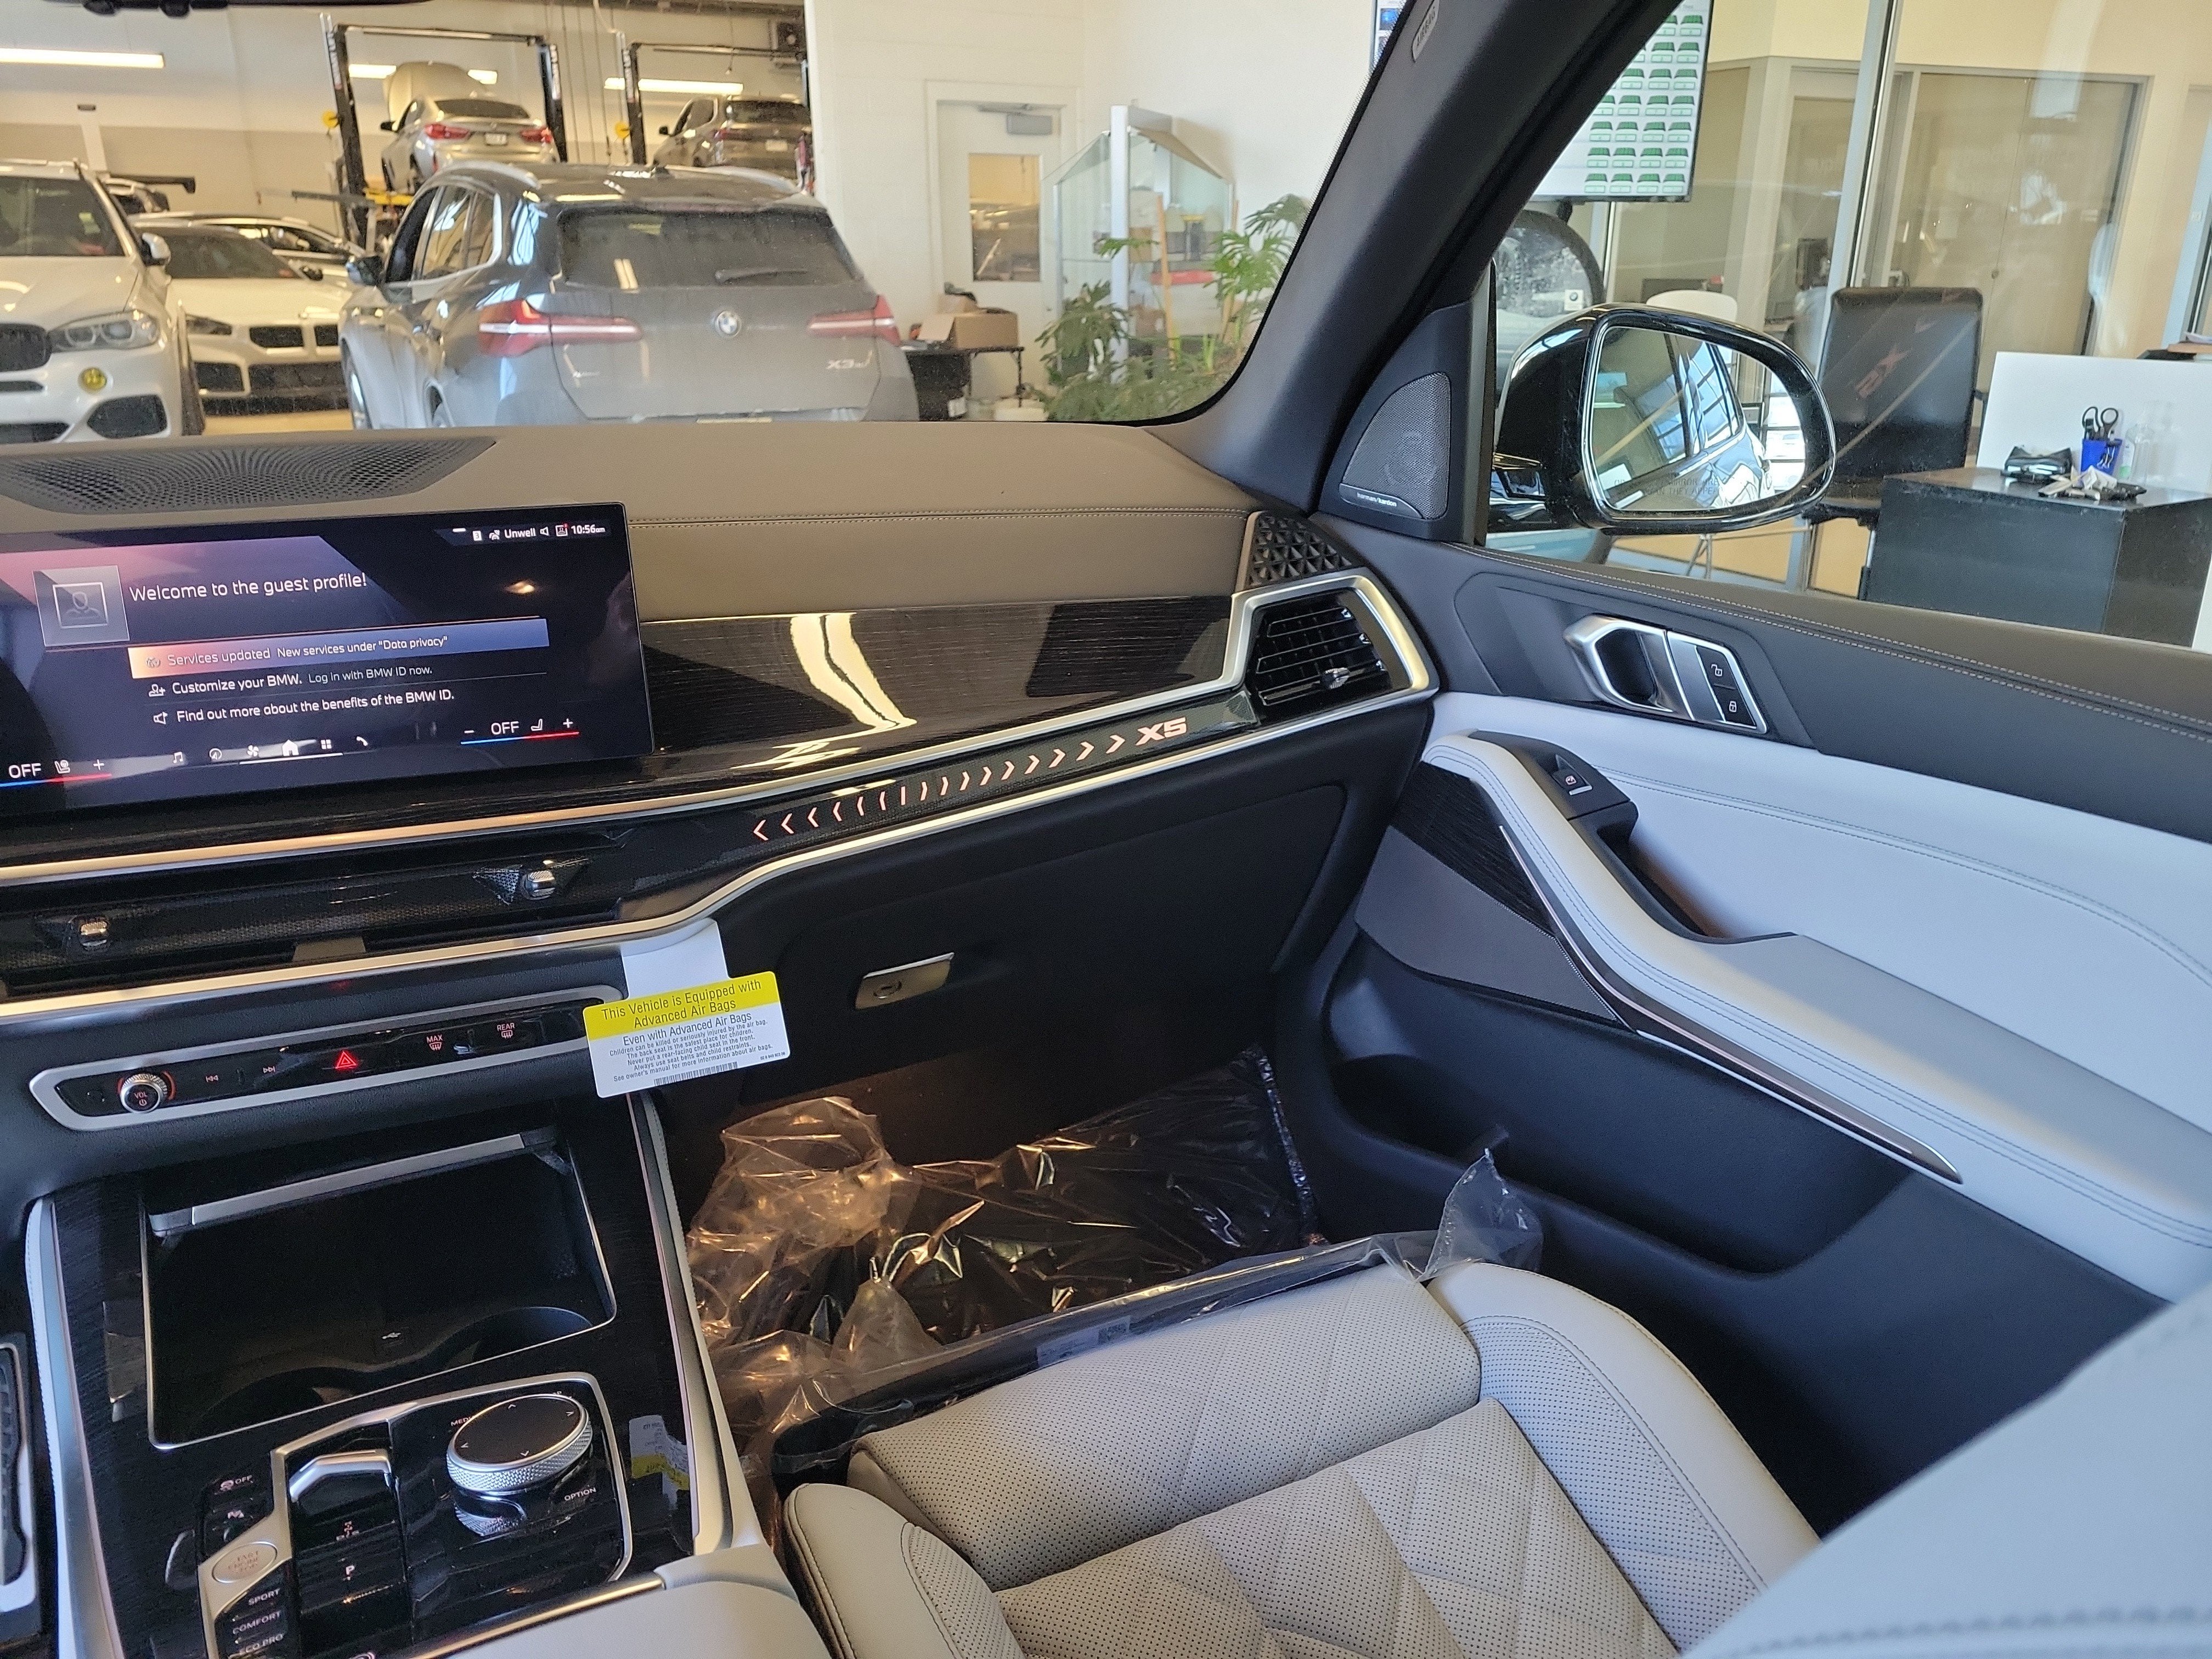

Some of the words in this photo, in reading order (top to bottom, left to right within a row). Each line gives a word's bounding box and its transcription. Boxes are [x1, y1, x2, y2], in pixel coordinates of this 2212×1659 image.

[504, 528, 536, 539] Unwell
[129, 585, 207, 601] Welcome
[211, 583, 228, 596] to
[233, 580, 258, 594] the
[264, 577, 309, 596] guest
[313, 572, 366, 592] profile!
[167, 653, 218, 666] Services
[222, 648, 270, 663] updated
[277, 647, 301, 658] New
[303, 644, 345, 656] services
[347, 642, 376, 653] under
[379, 640, 407, 650] "Data
[410, 636, 448, 650] privacy"
[172, 679, 235, 695] Customize
[238, 677, 264, 691] your
[267, 674, 302, 687] BMW.
[308, 673, 328, 685] Log
[330, 672, 340, 682] in
[342, 670, 364, 681] with
[366, 668, 393, 679] BMW
[396, 667, 407, 676] ID
[409, 667, 432, 676] now.
[177, 709, 204, 723] Find
[207, 709, 227, 720] out
[230, 707, 261, 719] more
[263, 703, 298, 715] about
[301, 701, 319, 712] the
[322, 697, 368, 710] benefits
[370, 695, 382, 706] of
[384, 694, 403, 705] the
[405, 690, 436, 704] BMW
[439, 689, 454, 701] ID.
[491, 721, 520, 735] OFF
[1136, 716, 1187, 746] X5
[9, 763, 42, 778] OFF
[601, 1006, 625, 1020] This
[629, 997, 669, 1014] Vehicle
[672, 995, 681, 1006] is
[685, 984, 735, 1005] Equipped
[738, 979, 761, 992] with
[633, 1008, 686, 1028] Advanced
[690, 1003, 706, 1016] Air
[709, 998, 736, 1014] Bags
[496, 1023, 515, 1031] REAR
[623, 1032, 645, 1046] Even
[647, 1029, 666, 1040] with
[668, 1019, 712, 1036] Advanced
[714, 1016, 727, 1026] Air
[729, 1011, 752, 1025] Bags
[426, 1034, 443, 1043] MAX
[610, 1046, 633, 1056] Children
[680, 1031, 705, 1041] seriously
[707, 1026, 726, 1036] injured
[685, 1038, 701, 1046] safest
[703, 1035, 718, 1043] place
[729, 1028, 753, 1037] children.
[740, 1034, 754, 1042] front.
[626, 1070, 648, 1079] owner's
[650, 1064, 670, 1073] manual
[698, 1052, 730, 1063] information
[731, 1048, 747, 1056] about
[634, 1062, 653, 1070] Always
[451, 1416, 471, 1426] MED
[564, 1486, 596, 1502] OPTION
[346, 1565, 355, 1576] P
[249, 1588, 280, 1605] SPORT
[233, 1611, 281, 1635] COMFORT
[262, 1633, 284, 1646] PRO
